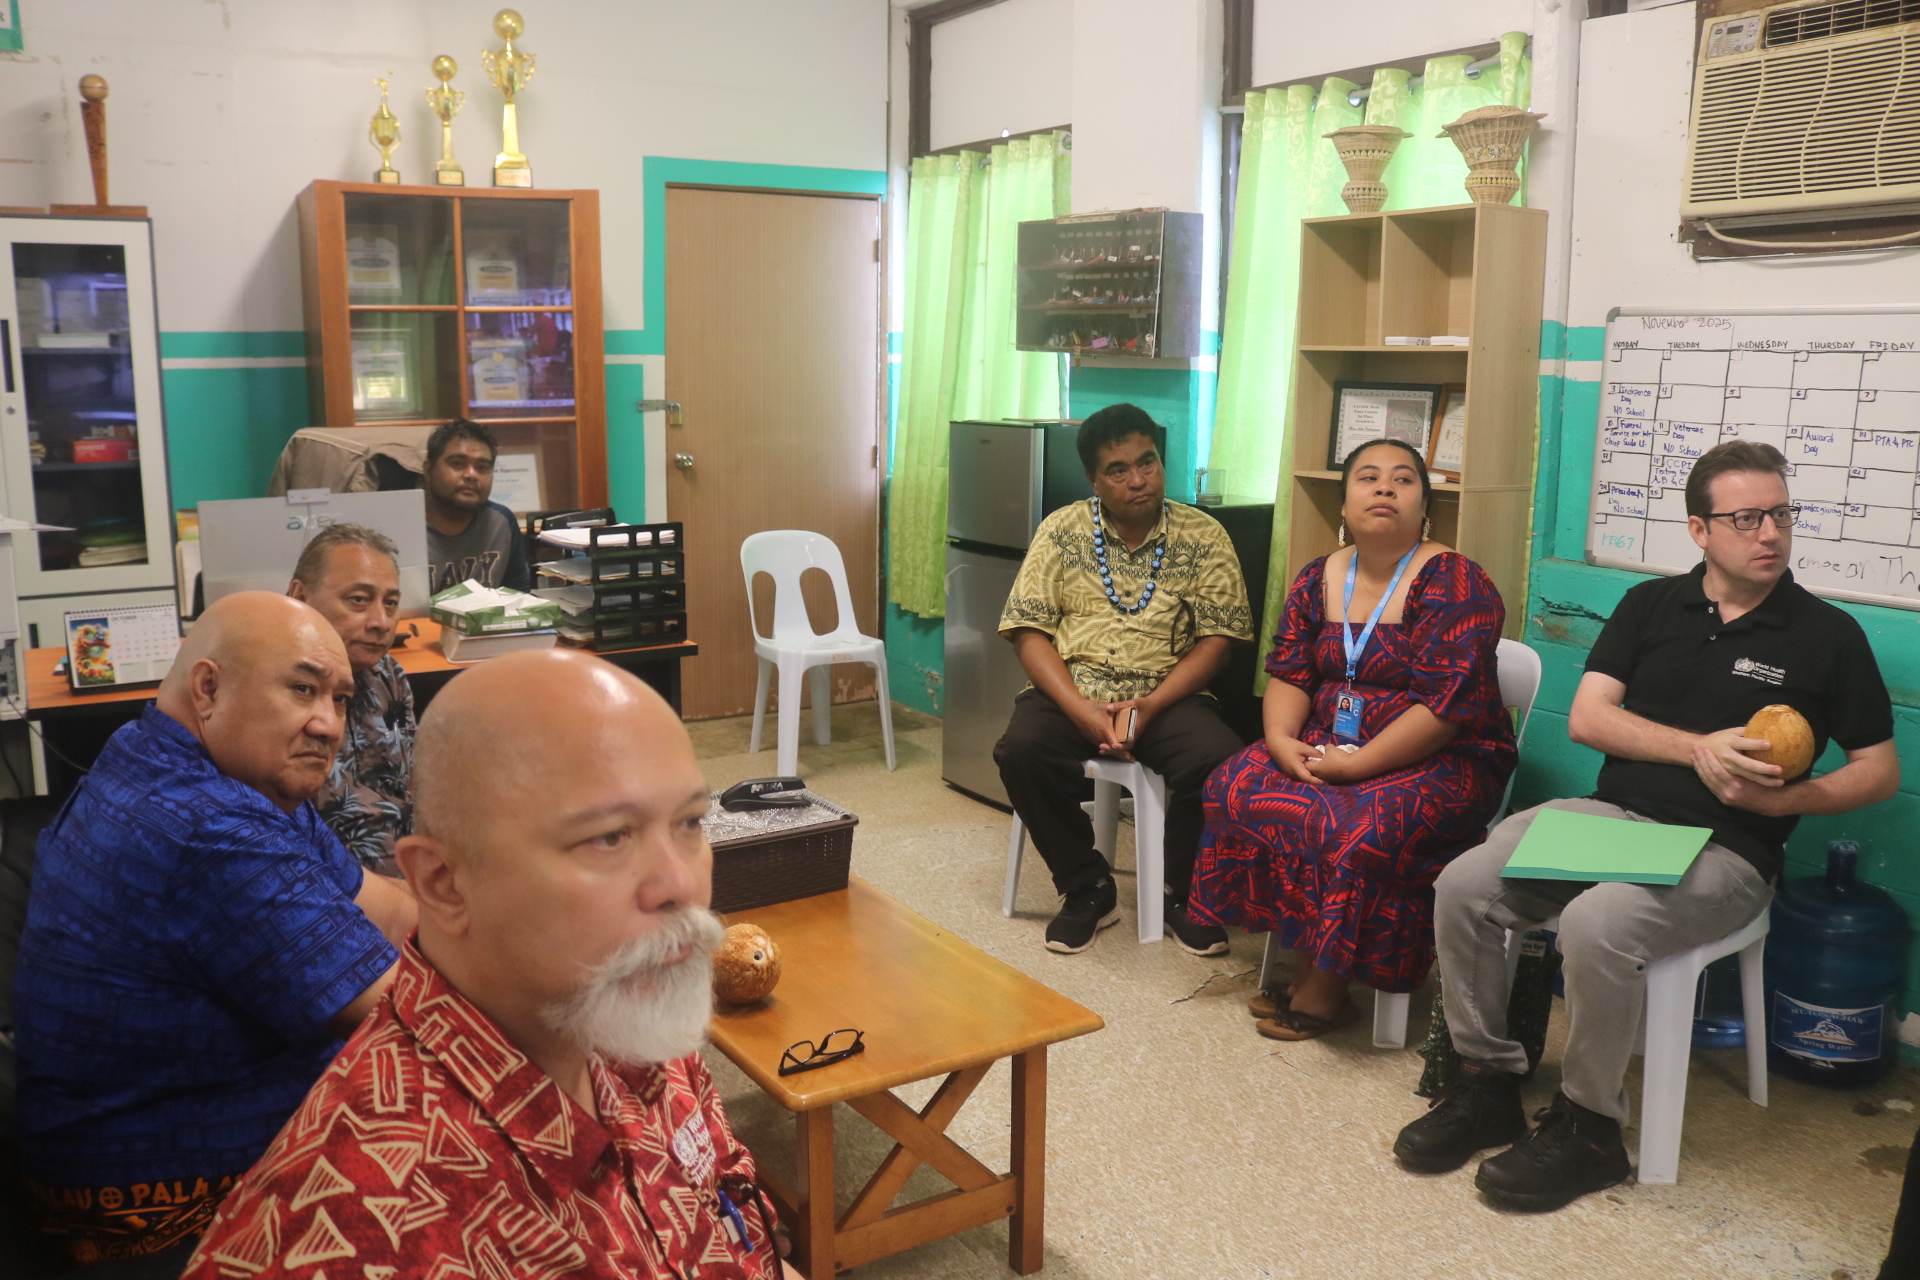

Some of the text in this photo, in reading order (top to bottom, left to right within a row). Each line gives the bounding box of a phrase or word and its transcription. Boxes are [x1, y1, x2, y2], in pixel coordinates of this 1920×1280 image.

[1698, 317, 1732, 331] 2025
[1737, 340, 1788, 349] WEDNESDAY
[1807, 341, 1855, 350] THURSDAY
[1626, 407, 1645, 417] School
[1673, 432, 1685, 442] Day
[1806, 430, 1834, 443] Award
[1876, 434, 1891, 446] PTA
[1901, 438, 1914, 448] PTC
[1679, 444, 1702, 456] School
[1804, 443, 1818, 457] Day
[1627, 505, 1646, 516] School
[1797, 520, 1822, 534] School
[1799, 1037, 1825, 1050] Spring
[1828, 1043, 1853, 1052] Water
